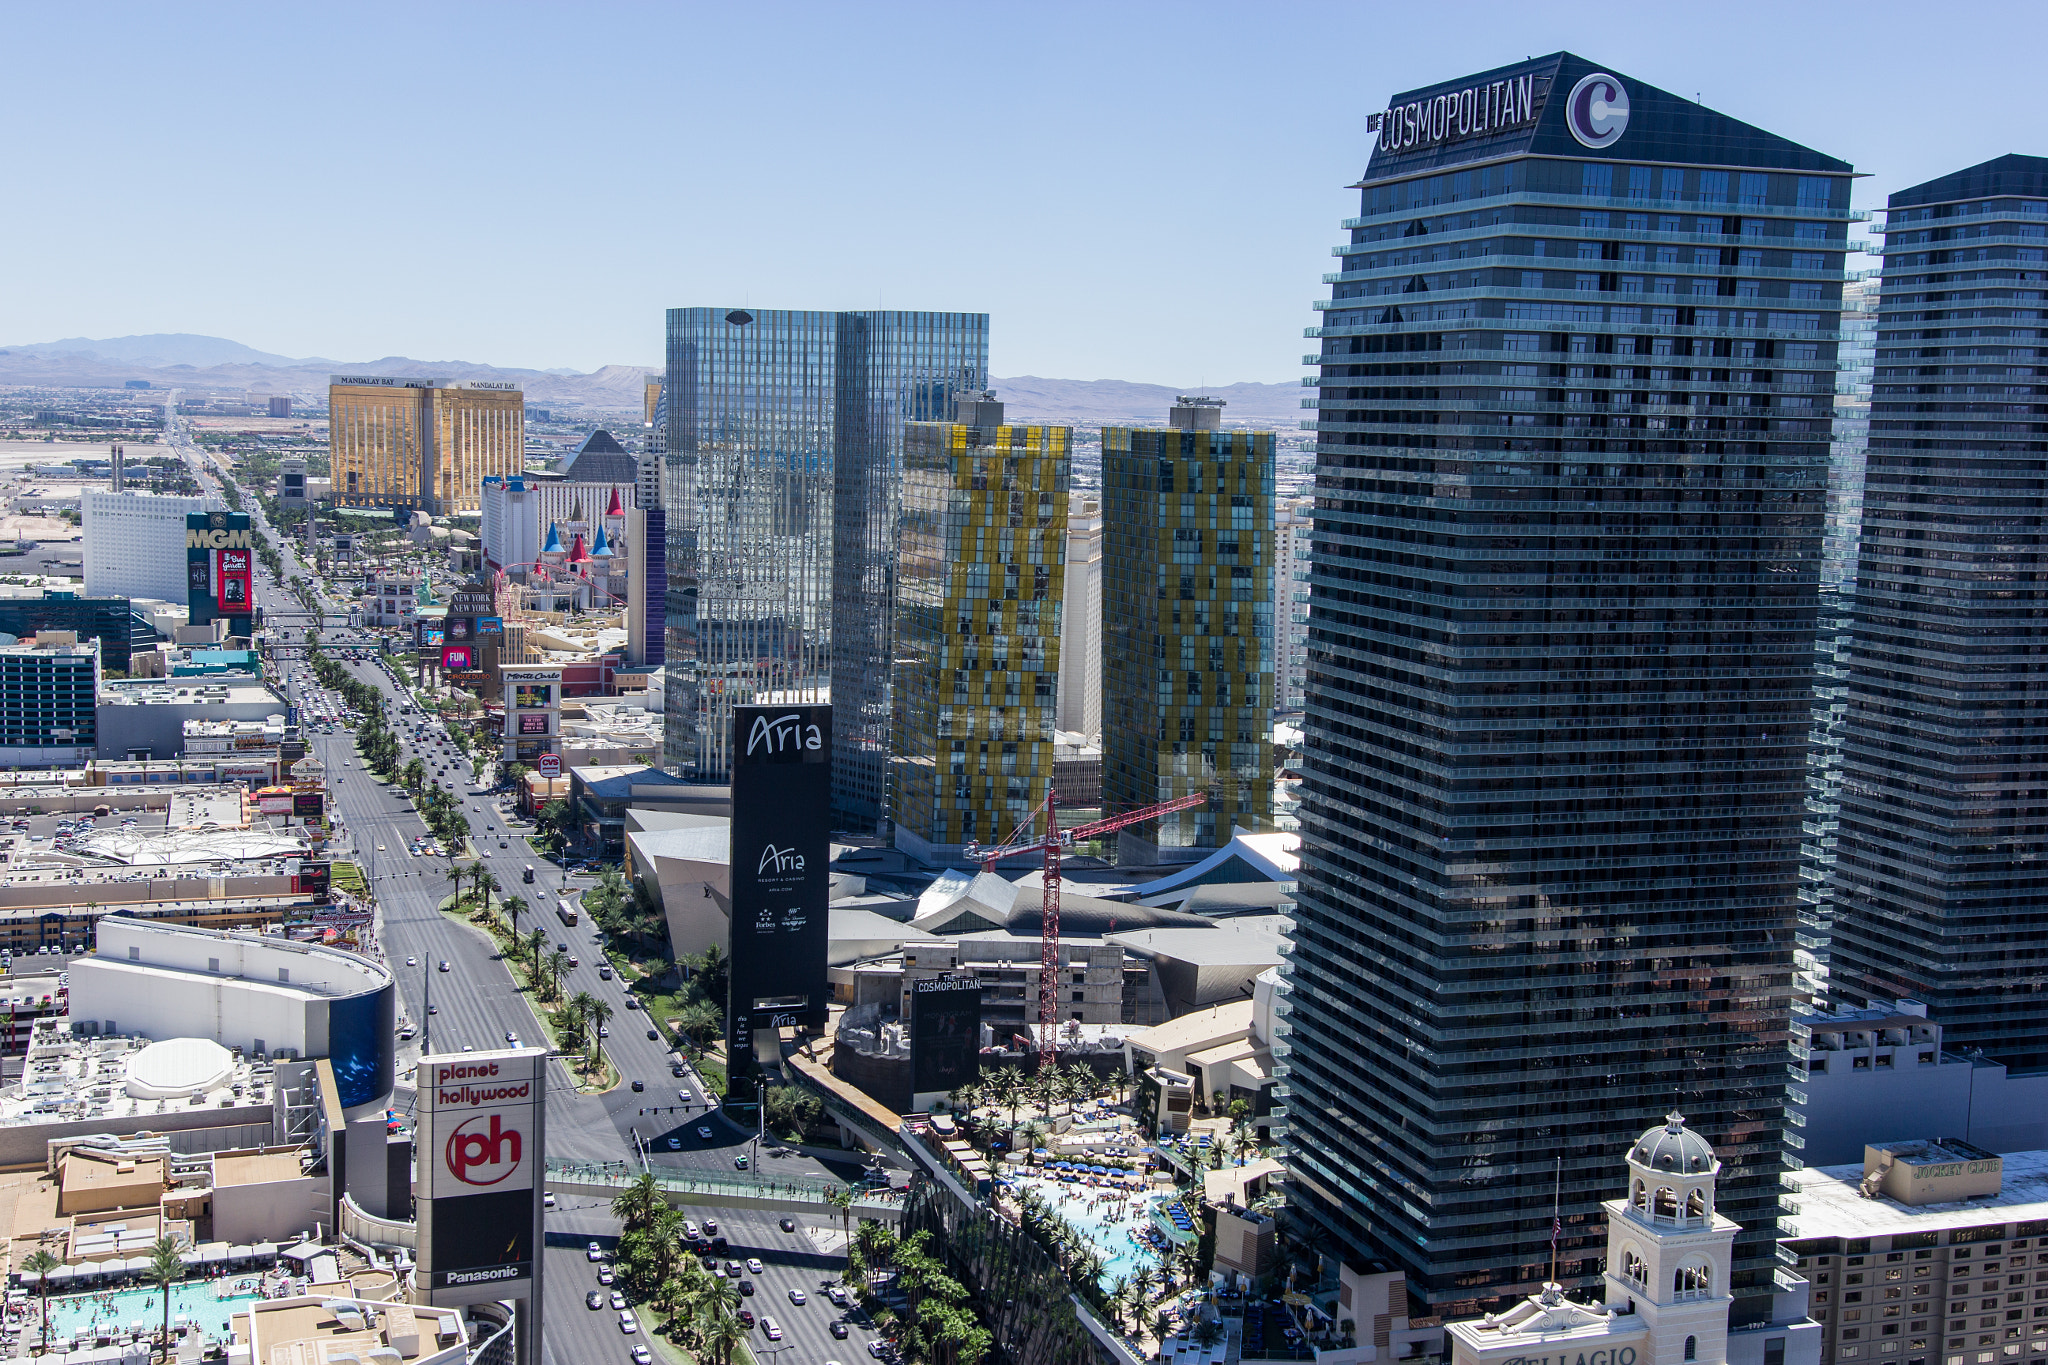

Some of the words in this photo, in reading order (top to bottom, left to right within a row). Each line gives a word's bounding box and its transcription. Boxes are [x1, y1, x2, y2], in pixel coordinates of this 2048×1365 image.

[1365, 112, 1383, 134] THE
[1379, 74, 1533, 152] COSMOPOLITAN
[341, 377, 380, 385] MANDALAY
[470, 381, 503, 389] MANDALAY
[185, 529, 252, 549] MGM
[472, 594, 490, 602] YORK
[454, 604, 470, 612] NEW
[472, 604, 490, 612] YORK
[450, 652, 464, 662] FUN
[747, 714, 822, 756] Aria
[758, 844, 805, 875] Aria
[919, 980, 981, 992] COSMOPOLITAN
[771, 1014, 796, 1028] Aria
[440, 1063, 499, 1084] planet
[440, 1082, 529, 1105] hollywood
[455, 1115, 522, 1180] ph
[1914, 1163, 1963, 1179] JOCKEY
[1968, 1160, 1999, 1174] CLUB
[447, 1265, 518, 1284] Panasonic
